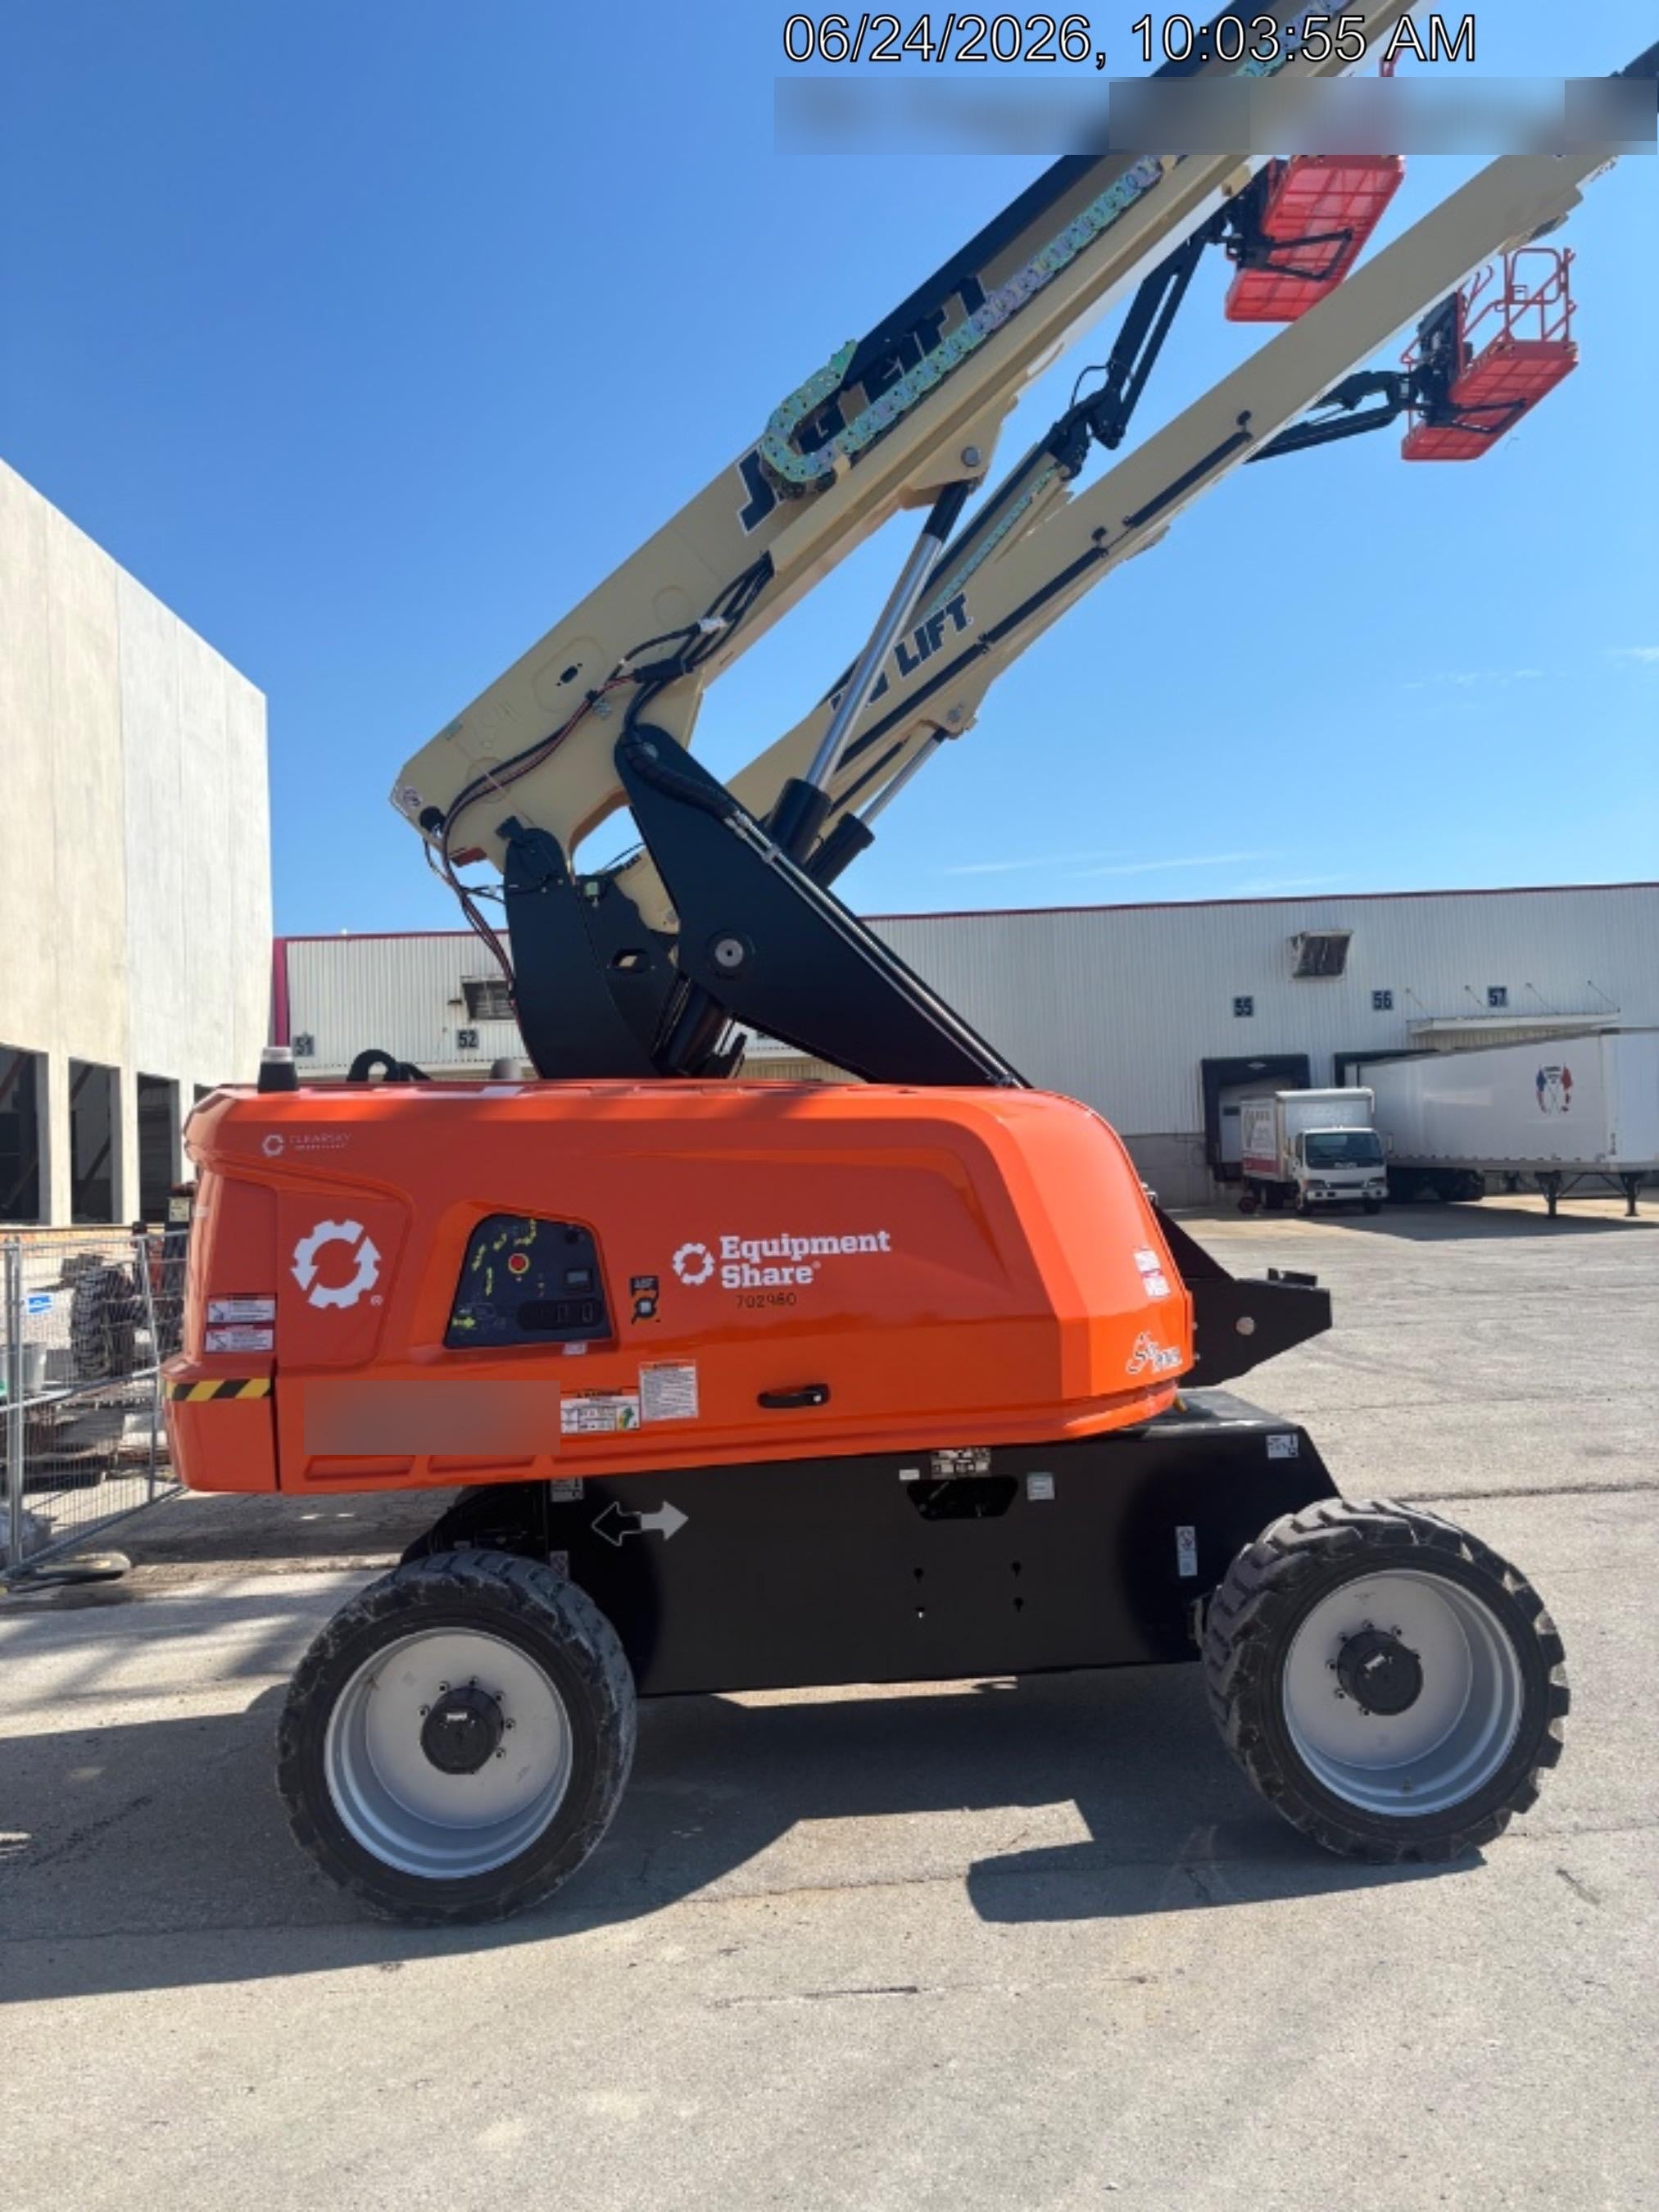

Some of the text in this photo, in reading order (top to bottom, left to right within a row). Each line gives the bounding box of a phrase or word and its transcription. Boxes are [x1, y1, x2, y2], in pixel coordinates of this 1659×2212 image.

[894, 592, 968, 678] LIFT
[1235, 997, 1253, 1016] 55
[1373, 991, 1392, 1009] 56
[1488, 987, 1507, 1007] 57
[459, 1030, 477, 1048] 52
[719, 1231, 891, 1263] Equipment
[721, 1262, 814, 1289] Share
